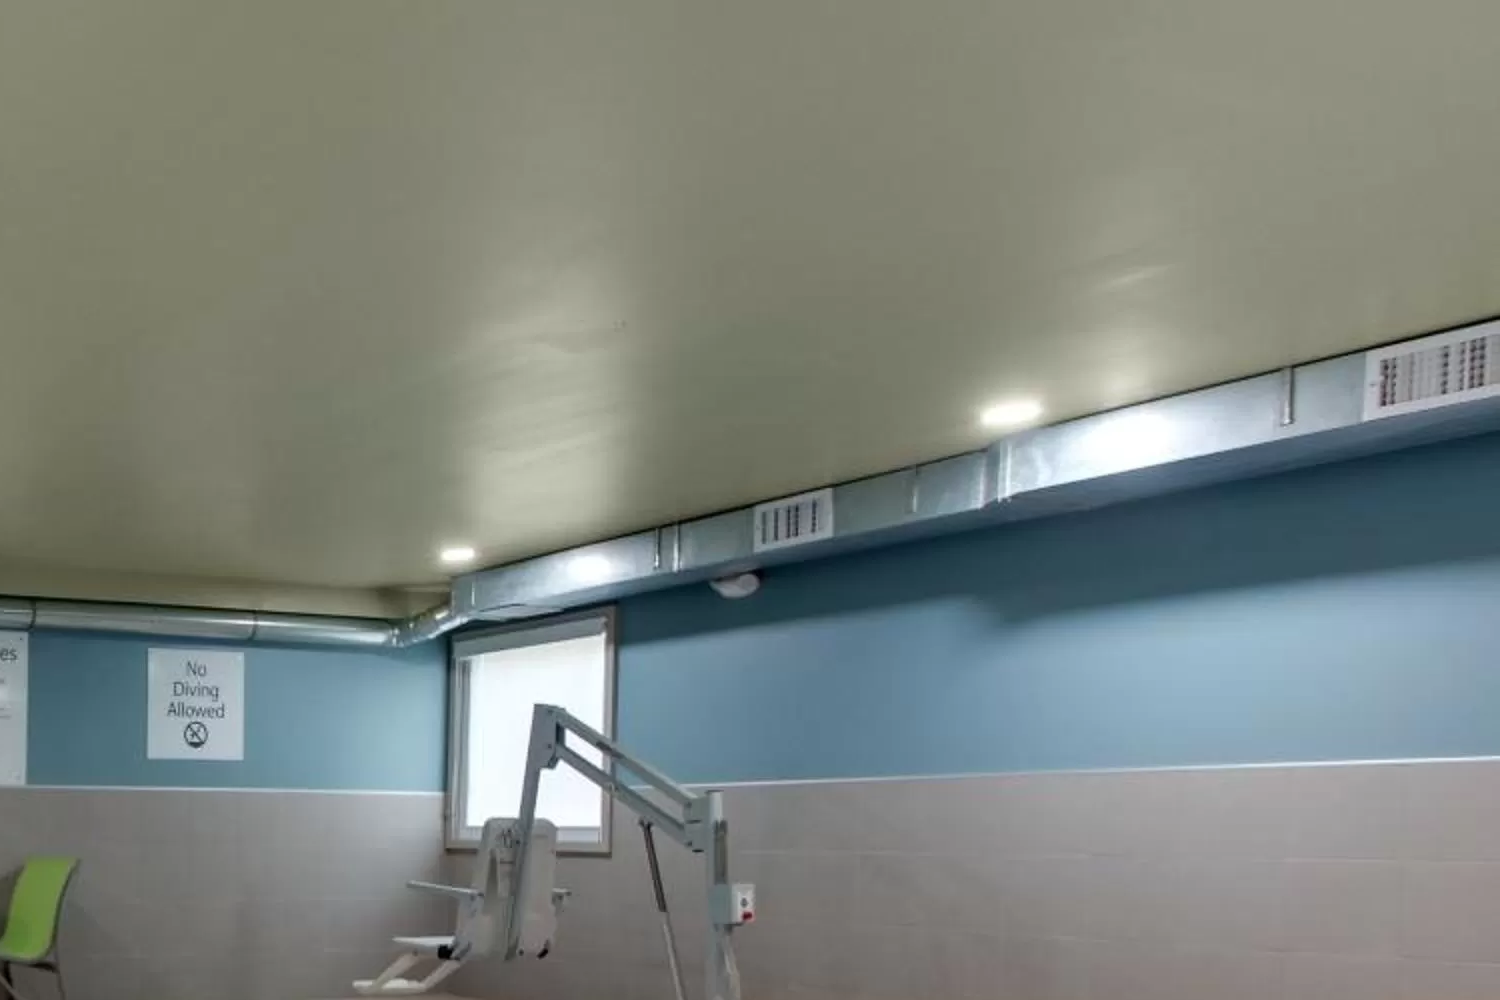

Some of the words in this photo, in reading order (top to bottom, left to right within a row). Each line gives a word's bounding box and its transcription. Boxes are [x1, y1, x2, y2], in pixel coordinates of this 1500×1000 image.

[185, 660, 207, 677] No
[172, 681, 220, 702] Diving
[166, 701, 225, 719] Allowed
